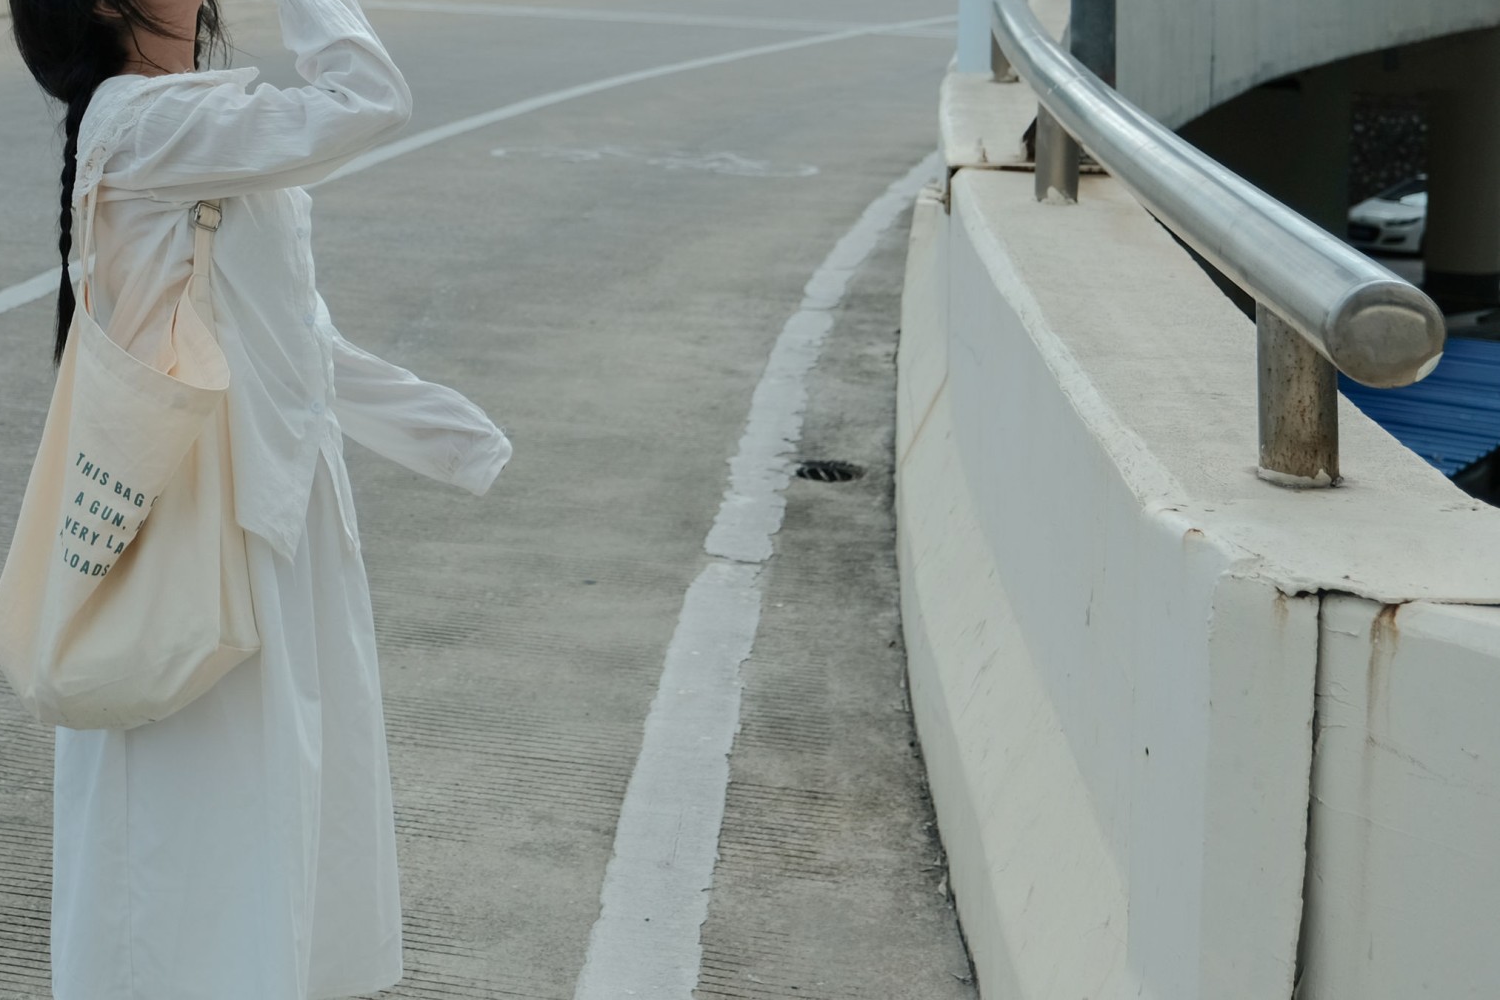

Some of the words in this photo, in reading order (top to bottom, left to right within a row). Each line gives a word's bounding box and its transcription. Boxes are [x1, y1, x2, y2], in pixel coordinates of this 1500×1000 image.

[76, 452, 110, 486] THIS
[114, 481, 145, 508] BAG
[74, 491, 85, 506] A
[89, 500, 126, 530] GUN.
